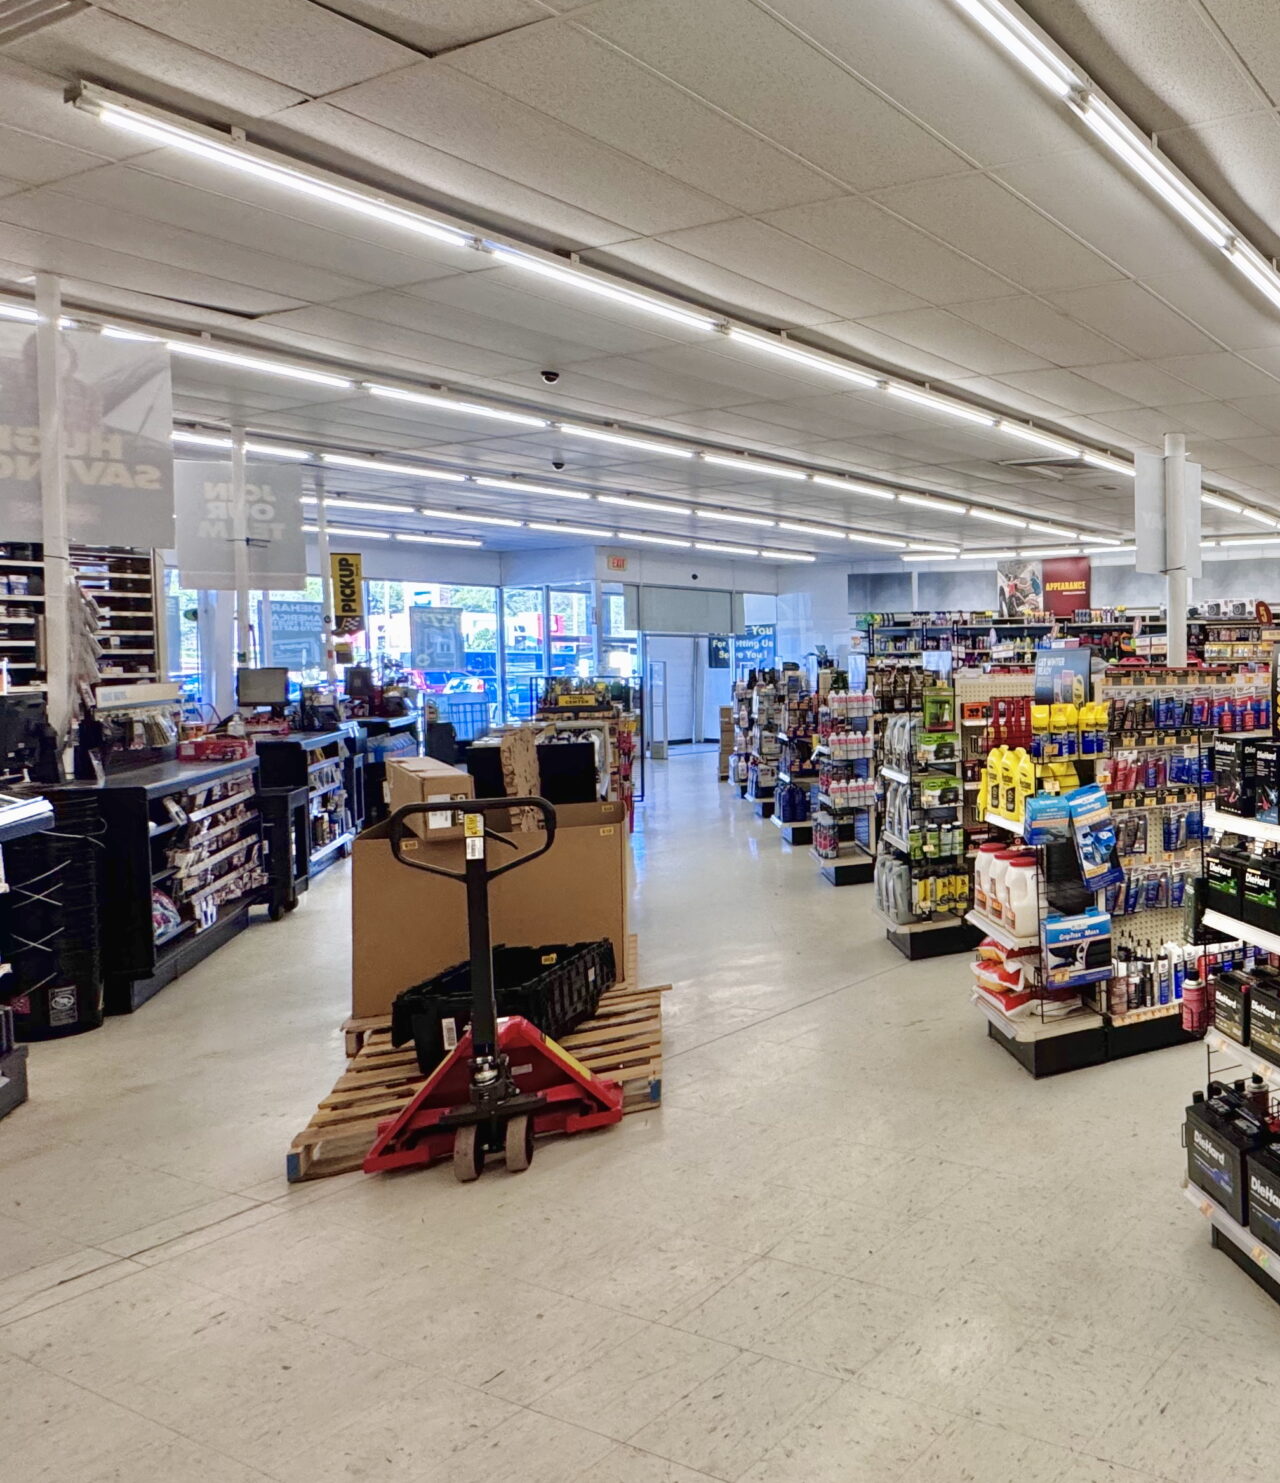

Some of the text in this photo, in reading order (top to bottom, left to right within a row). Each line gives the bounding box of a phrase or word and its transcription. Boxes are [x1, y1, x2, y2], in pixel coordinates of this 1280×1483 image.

[612, 558, 625, 569] EXIT
[338, 556, 358, 614] PICKUP
[1046, 581, 1086, 592] APPEARANCE
[1260, 606, 1268, 623] 5
[752, 626, 772, 635] You
[712, 640, 726, 648] For
[1215, 741, 1236, 753] DieHard
[1256, 750, 1277, 760] DieHard
[1209, 861, 1232, 878] DieHard
[1245, 872, 1270, 888] DieHard
[1216, 990, 1237, 1009] DieHard
[1251, 1000, 1276, 1020] DieHard
[1194, 1130, 1225, 1166] DieHard
